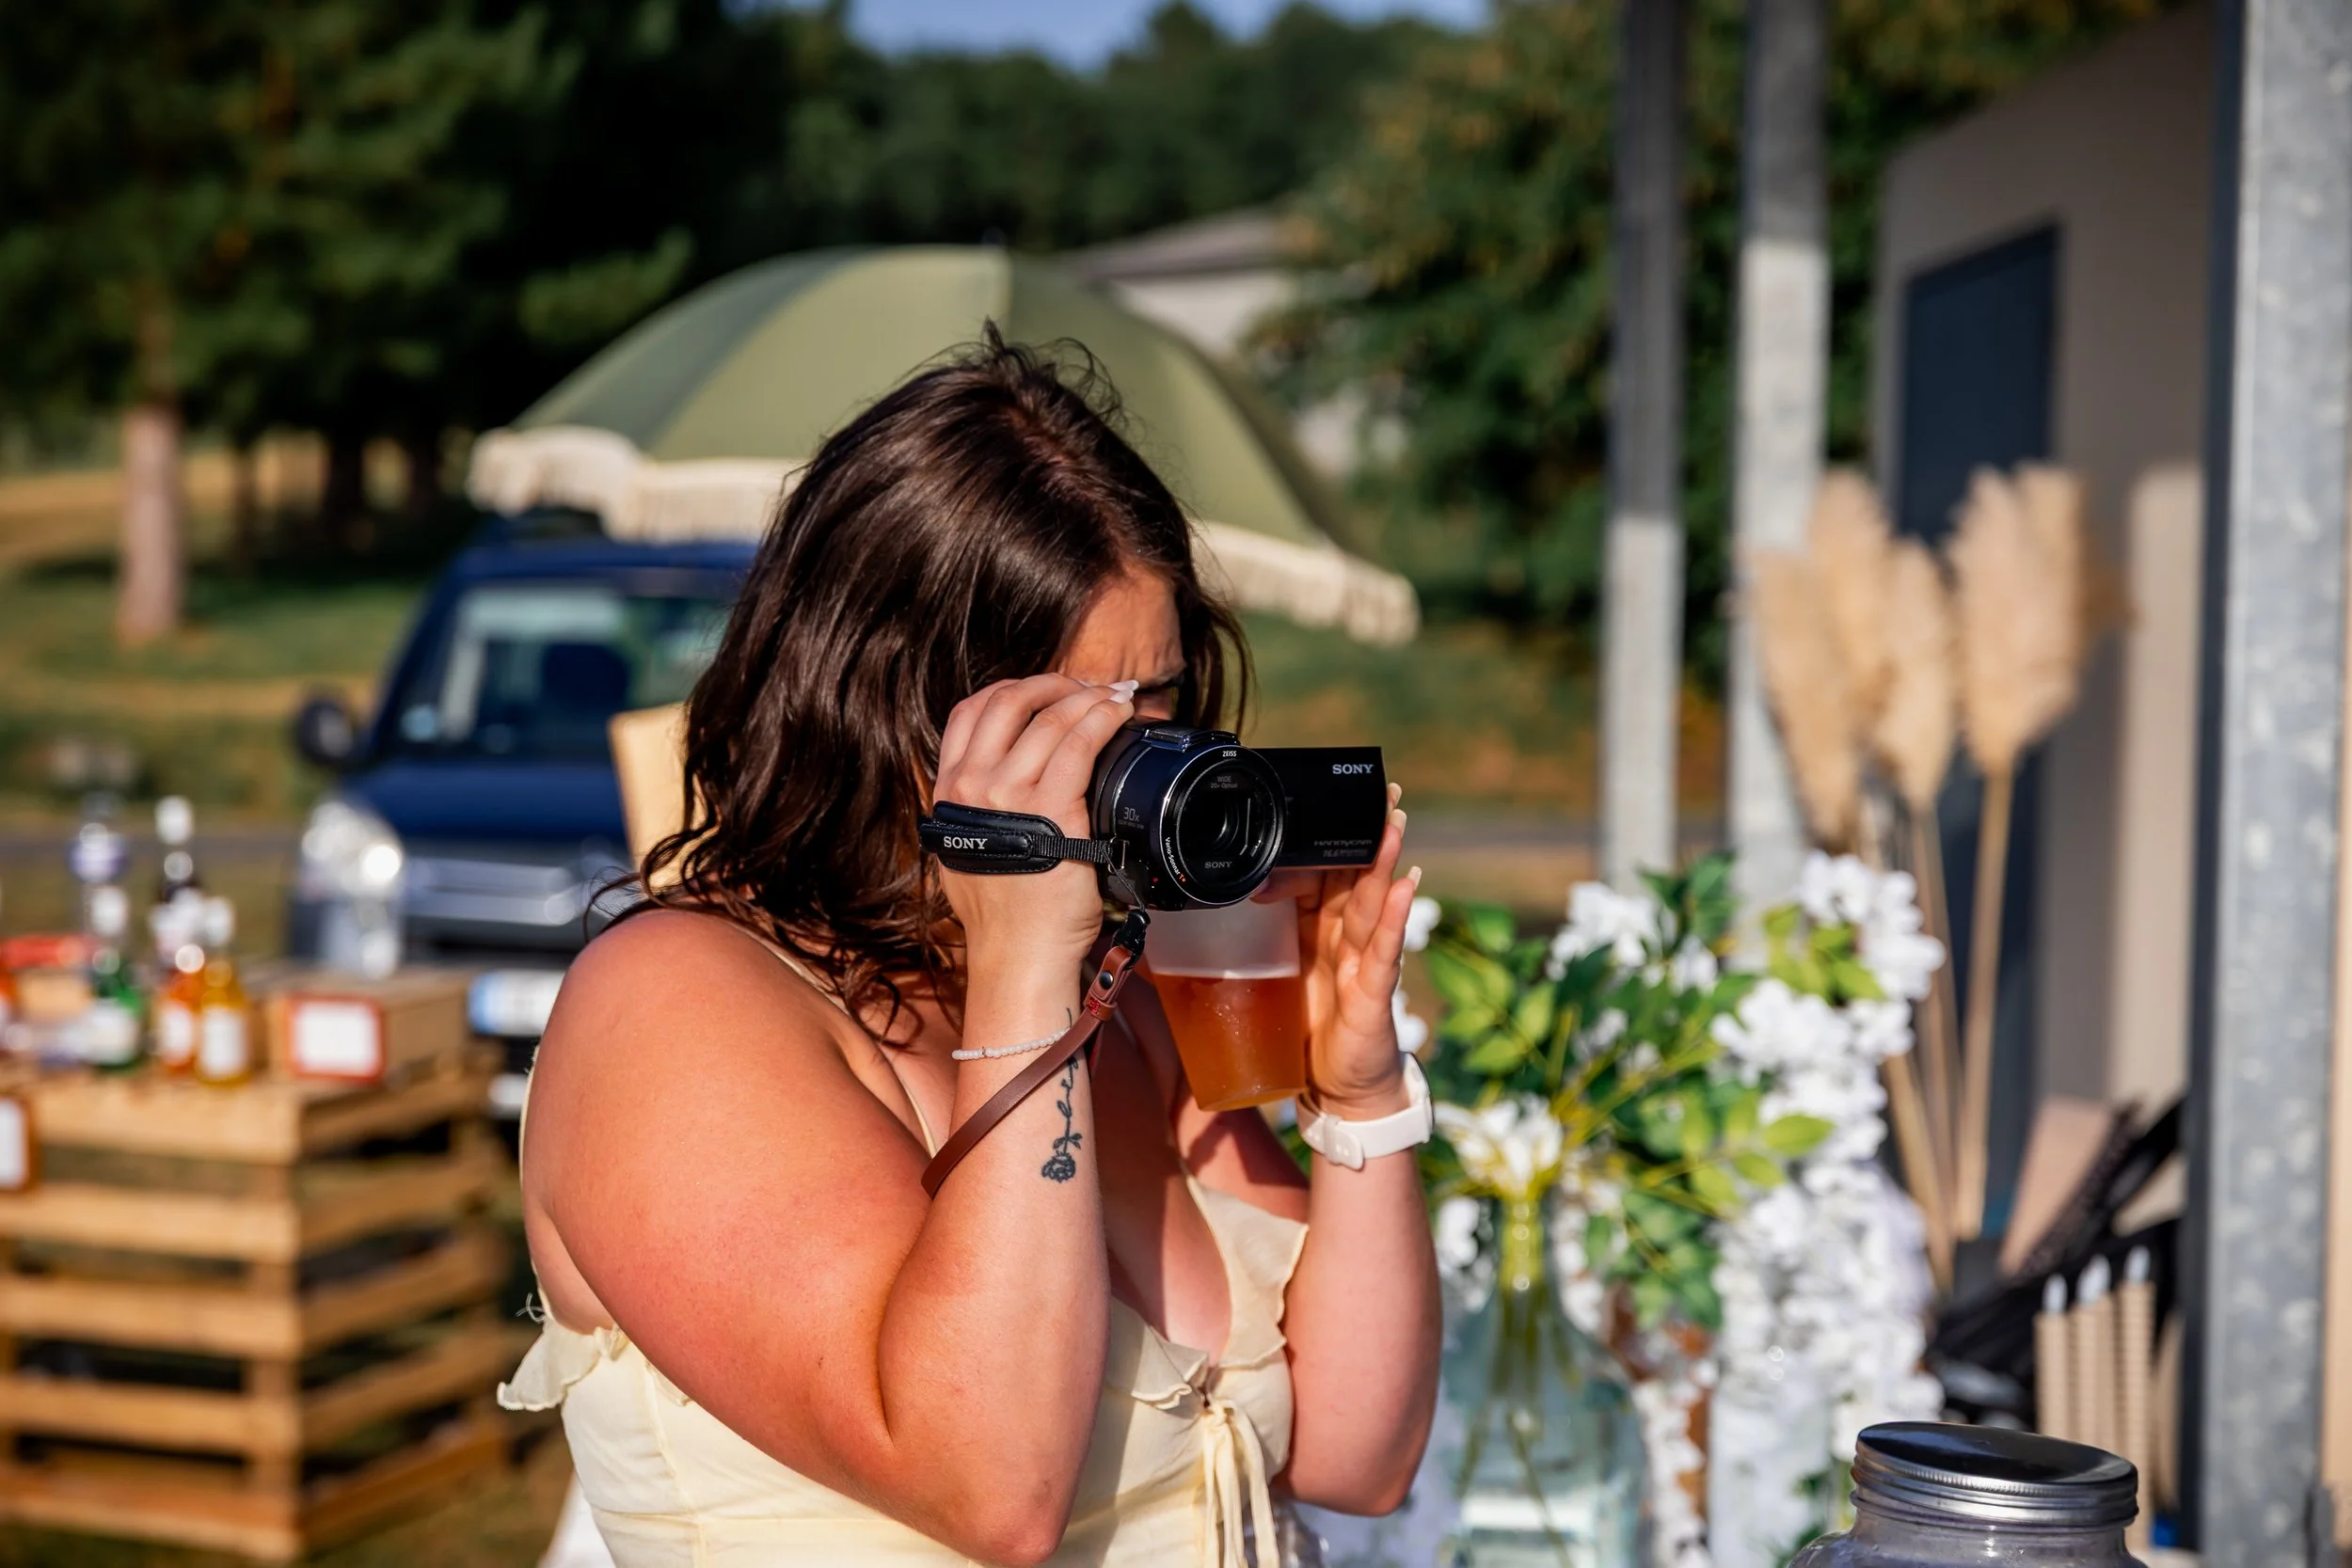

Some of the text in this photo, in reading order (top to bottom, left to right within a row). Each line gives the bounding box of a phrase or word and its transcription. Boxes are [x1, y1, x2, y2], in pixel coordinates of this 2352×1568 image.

[1332, 764, 1374, 774] SONY
[1123, 806, 1140, 822] 30x
[943, 835, 989, 850] SONY
[1165, 836, 1181, 875] Vario-Sonnar
[1204, 861, 1232, 869] SONY
